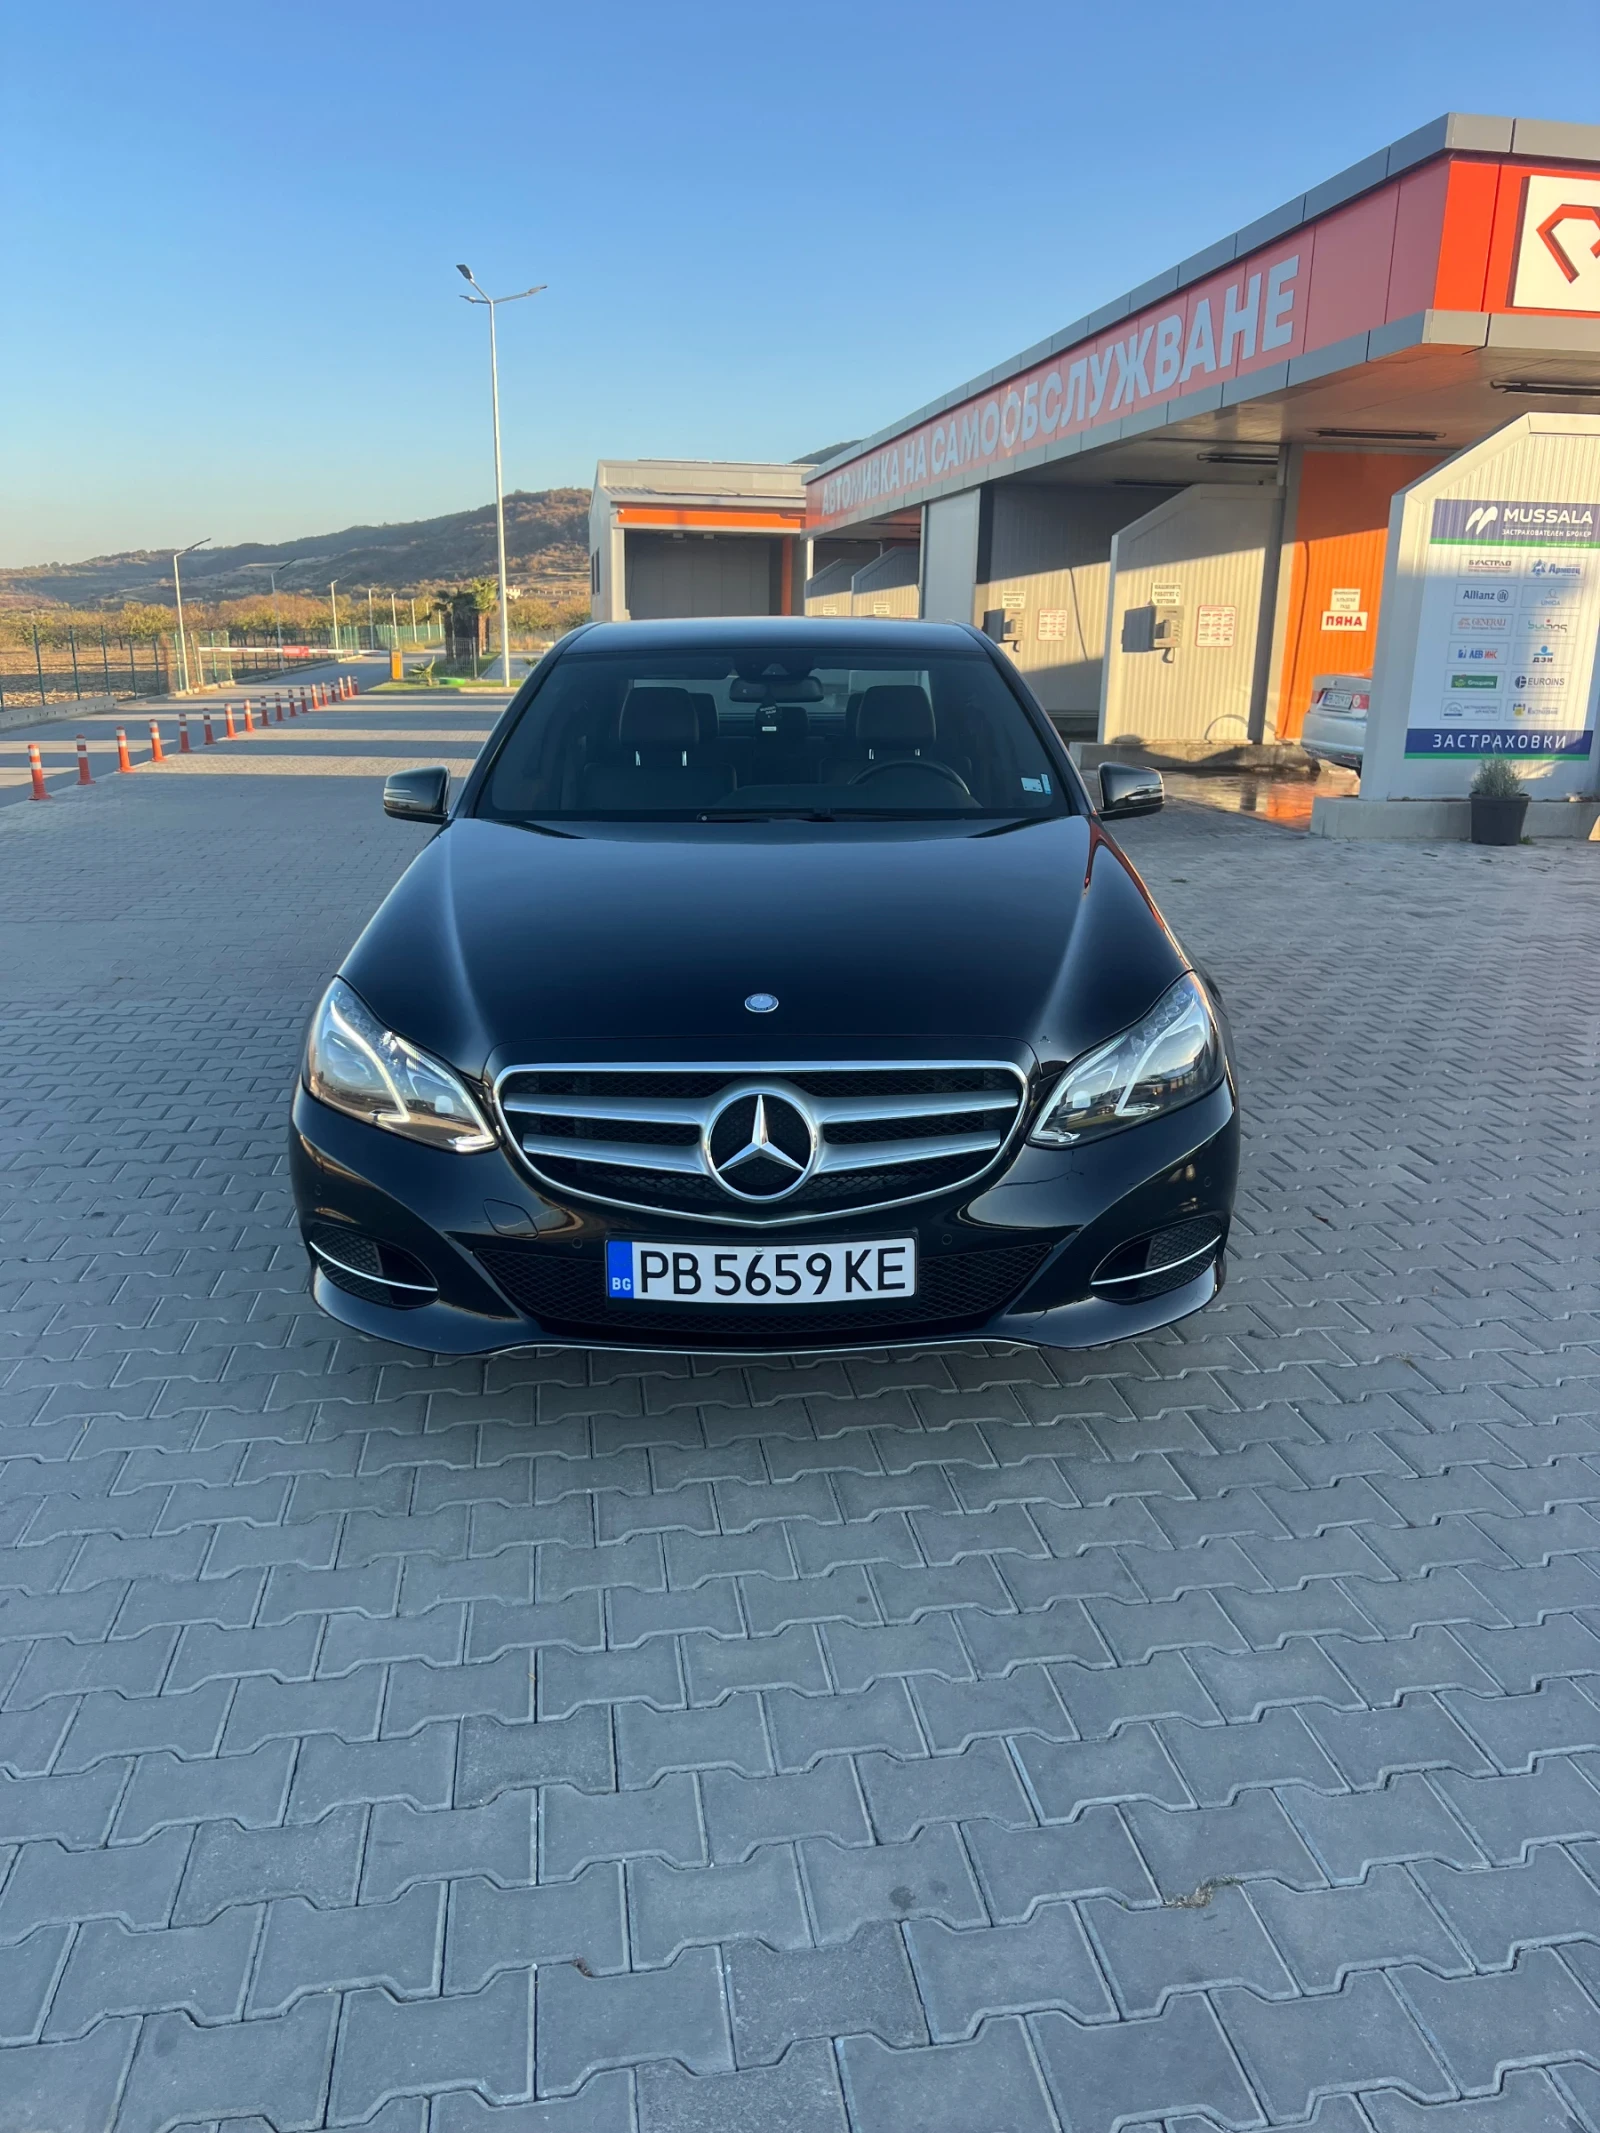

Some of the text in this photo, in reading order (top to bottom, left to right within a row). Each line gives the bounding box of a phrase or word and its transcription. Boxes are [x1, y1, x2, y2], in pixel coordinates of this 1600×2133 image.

[822, 254, 1300, 516] АВТОМИВКА НА САМООБСЛУЖВАНЕ
[1503, 508, 1593, 524] MUSSALA
[1501, 528, 1592, 538] ЗАСТРАХОВАТЕЛЕН БРОКЕР
[1463, 590, 1496, 600] Allianz
[1325, 615, 1363, 627] ПЯНА
[1471, 617, 1507, 626] GENERALI
[1527, 678, 1565, 686] EUROINS
[1432, 734, 1566, 749] ЗАСТРАХОВКИ
[640, 1246, 906, 1296] PB 5659 KE
[612, 1277, 632, 1291] BG
